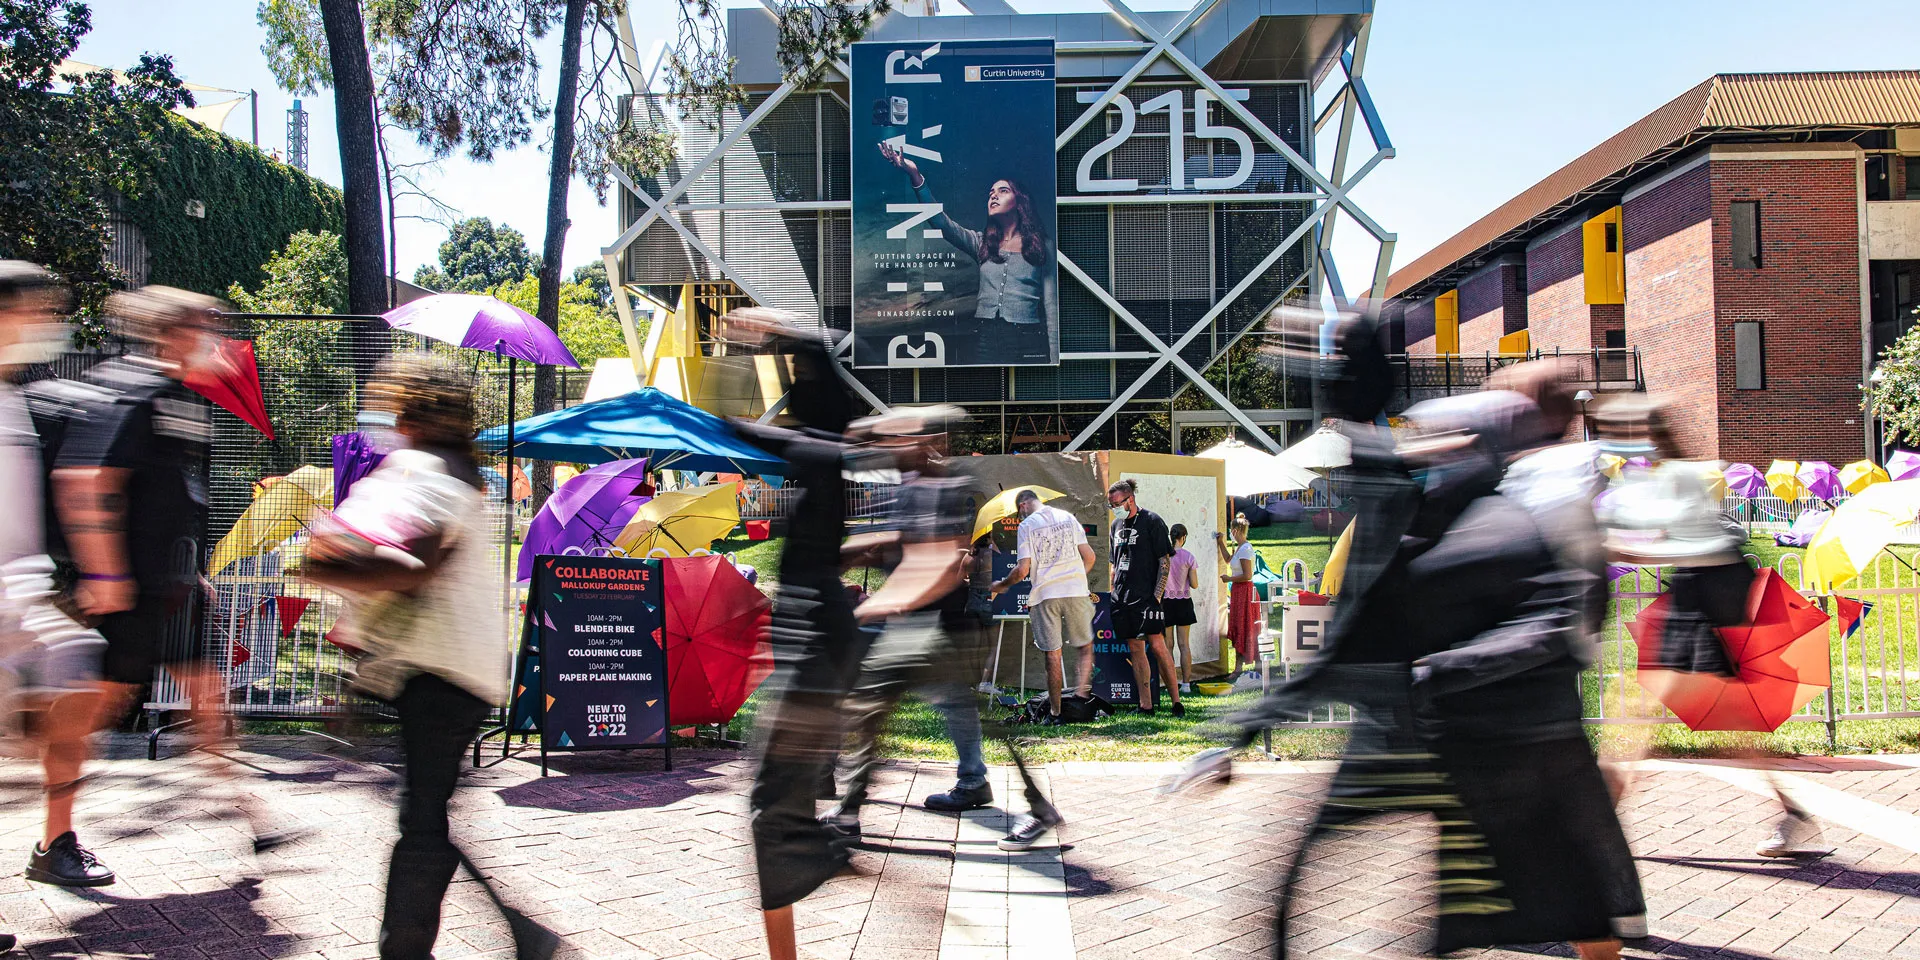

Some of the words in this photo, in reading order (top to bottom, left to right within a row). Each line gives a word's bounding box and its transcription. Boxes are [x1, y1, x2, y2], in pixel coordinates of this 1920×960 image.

[983, 69, 1006, 78] Curtin
[1007, 68, 1045, 78] University
[1076, 88, 1254, 192] 215
[915, 252, 943, 260] SPACE
[555, 566, 650, 581] COLLABORATE
[561, 581, 607, 590] MALLOKUP
[607, 582, 646, 591] GARDENS
[587, 614, 604, 622] 10AM
[608, 614, 623, 622] 2PM
[574, 624, 614, 633] BLENDER
[615, 625, 635, 633] BIKE
[588, 638, 605, 646] 10AM
[609, 638, 623, 646] 2PM
[567, 648, 619, 657] COLOURING
[620, 649, 643, 657] CUBE
[1092, 643, 1109, 653] ME
[588, 662, 606, 670] 10AM
[610, 662, 624, 670] 2PM
[559, 673, 588, 681] PAPER
[589, 673, 617, 681] PLANE
[618, 673, 652, 681] MAKING
[587, 704, 610, 714] NEW
[611, 704, 626, 713] TO
[588, 714, 626, 723] CURTIN
